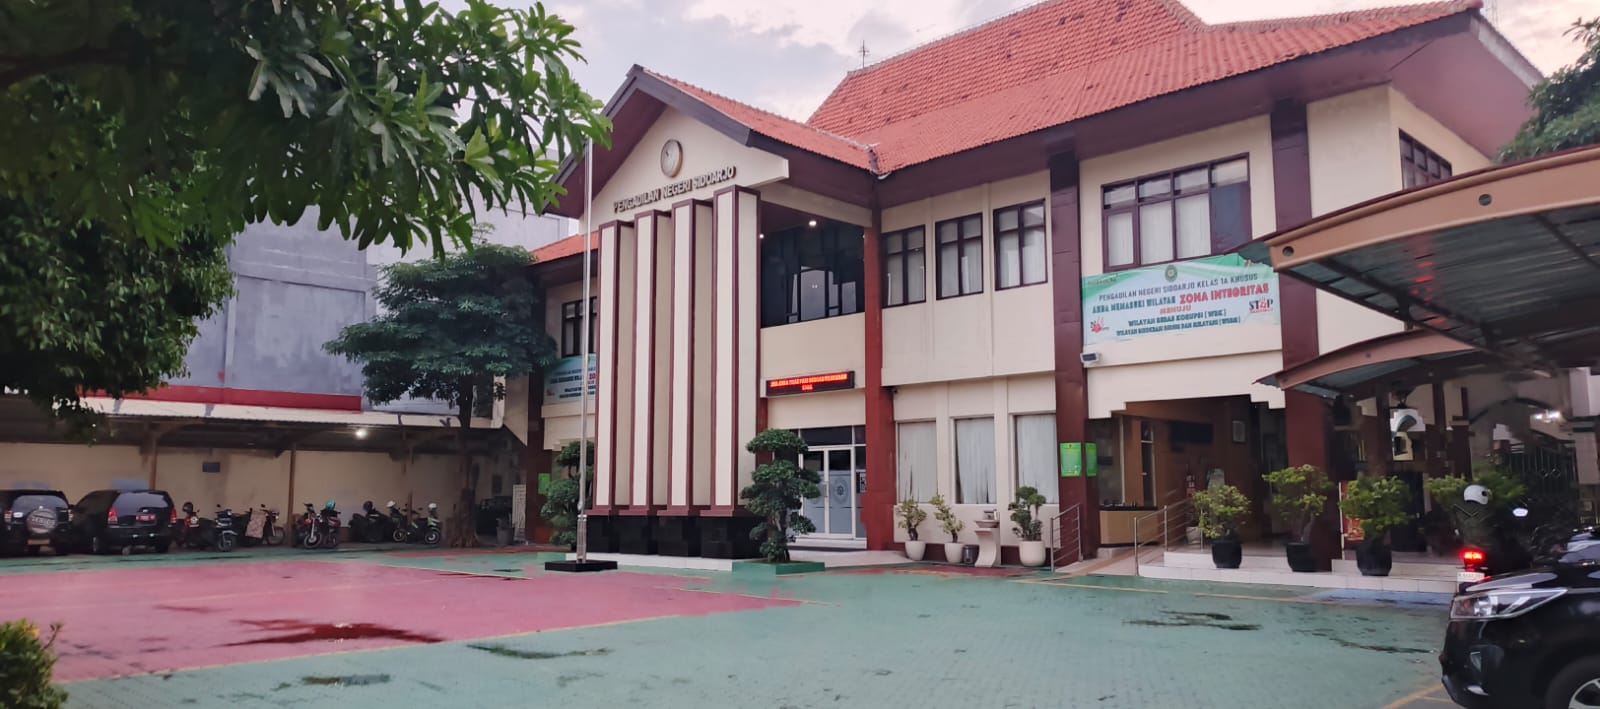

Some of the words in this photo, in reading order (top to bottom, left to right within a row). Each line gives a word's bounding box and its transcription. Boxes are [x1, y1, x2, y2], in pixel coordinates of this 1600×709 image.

[613, 188, 661, 214] PENGADILAN
[662, 178, 693, 199] NEGERI
[693, 166, 737, 190] SIDOARJO
[1098, 290, 1137, 302] PENGADILAN
[1138, 286, 1162, 297] NEGERI
[1162, 281, 1195, 293] SIDOARJO
[1197, 279, 1219, 289] KELAS
[1230, 273, 1258, 283] KHUSUS
[1110, 300, 1145, 312] MEMASUKI
[1146, 295, 1176, 307] WILAYAH
[1179, 291, 1208, 304] ZONA
[1210, 282, 1270, 301] INTEGRITAS
